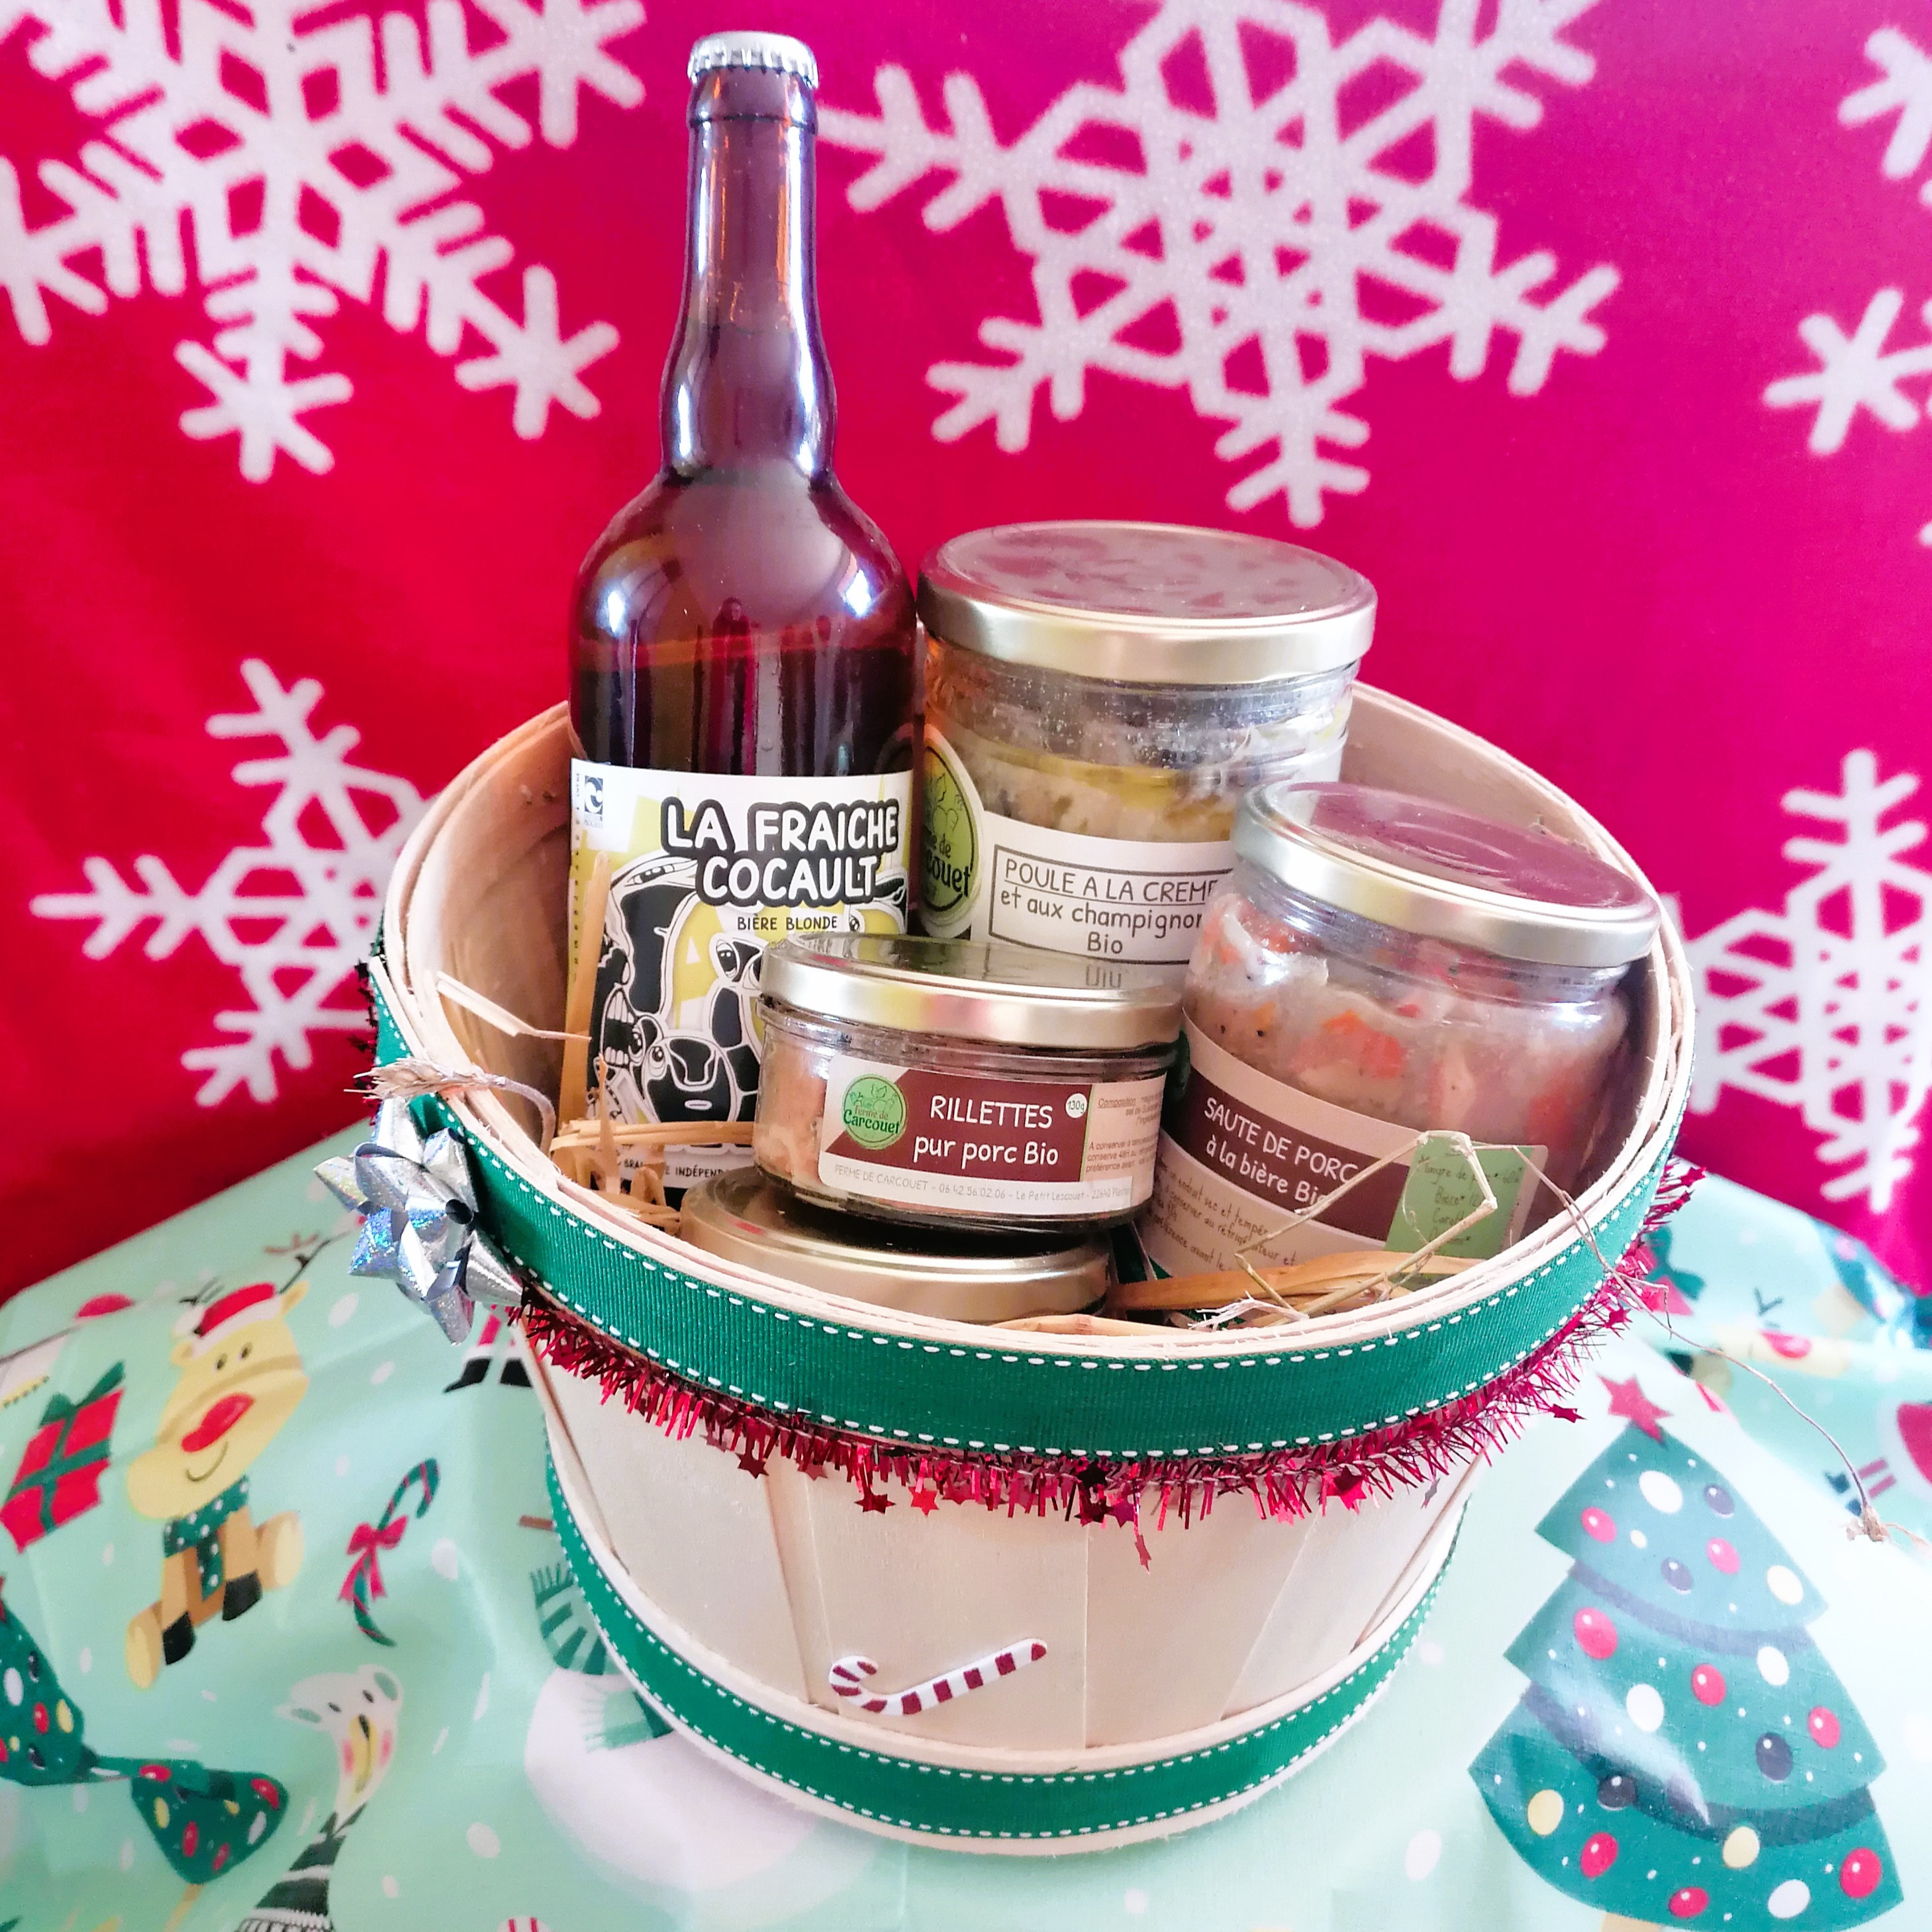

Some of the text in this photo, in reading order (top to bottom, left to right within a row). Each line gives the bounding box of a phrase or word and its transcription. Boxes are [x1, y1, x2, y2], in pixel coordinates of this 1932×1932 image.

[662, 797, 899, 855] LA FRAICHE
[939, 833, 951, 858] de
[699, 853, 881, 904] COCAULT
[1004, 859, 1075, 894] POULE
[1083, 877, 1098, 898] A
[1106, 879, 1134, 901] LA
[737, 912, 838, 931] BIÈRE BLONDE
[1000, 888, 1202, 939] et aux champigno
[1087, 932, 1123, 955] Bio
[843, 1109, 900, 1135] Carcouet
[879, 1110, 889, 1121] de
[929, 1094, 1053, 1130] RILLETTES
[1067, 1100, 1085, 1114] 130g
[912, 1135, 1059, 1170] pur porc Bio
[1204, 1096, 1261, 1146] SAUTE
[1262, 1130, 1292, 1160] DE
[1294, 1145, 1359, 1184] PORC
[675, 1164, 724, 1179] INDÉPEND
[835, 1163, 861, 1179] FERME
[863, 1171, 874, 1183] DE
[877, 1173, 928, 1191] CARCOUET
[1016, 1190, 1026, 1200] Le
[1028, 1190, 1051, 1200] Petit
[1206, 1134, 1217, 1157] à
[1219, 1140, 1237, 1170] la
[1239, 1152, 1288, 1194] bière
[1204, 1198, 1218, 1212] sec
[1221, 1204, 1232, 1219] et
[1234, 1207, 1269, 1241] tempér
[1283, 1250, 1296, 1267] et
